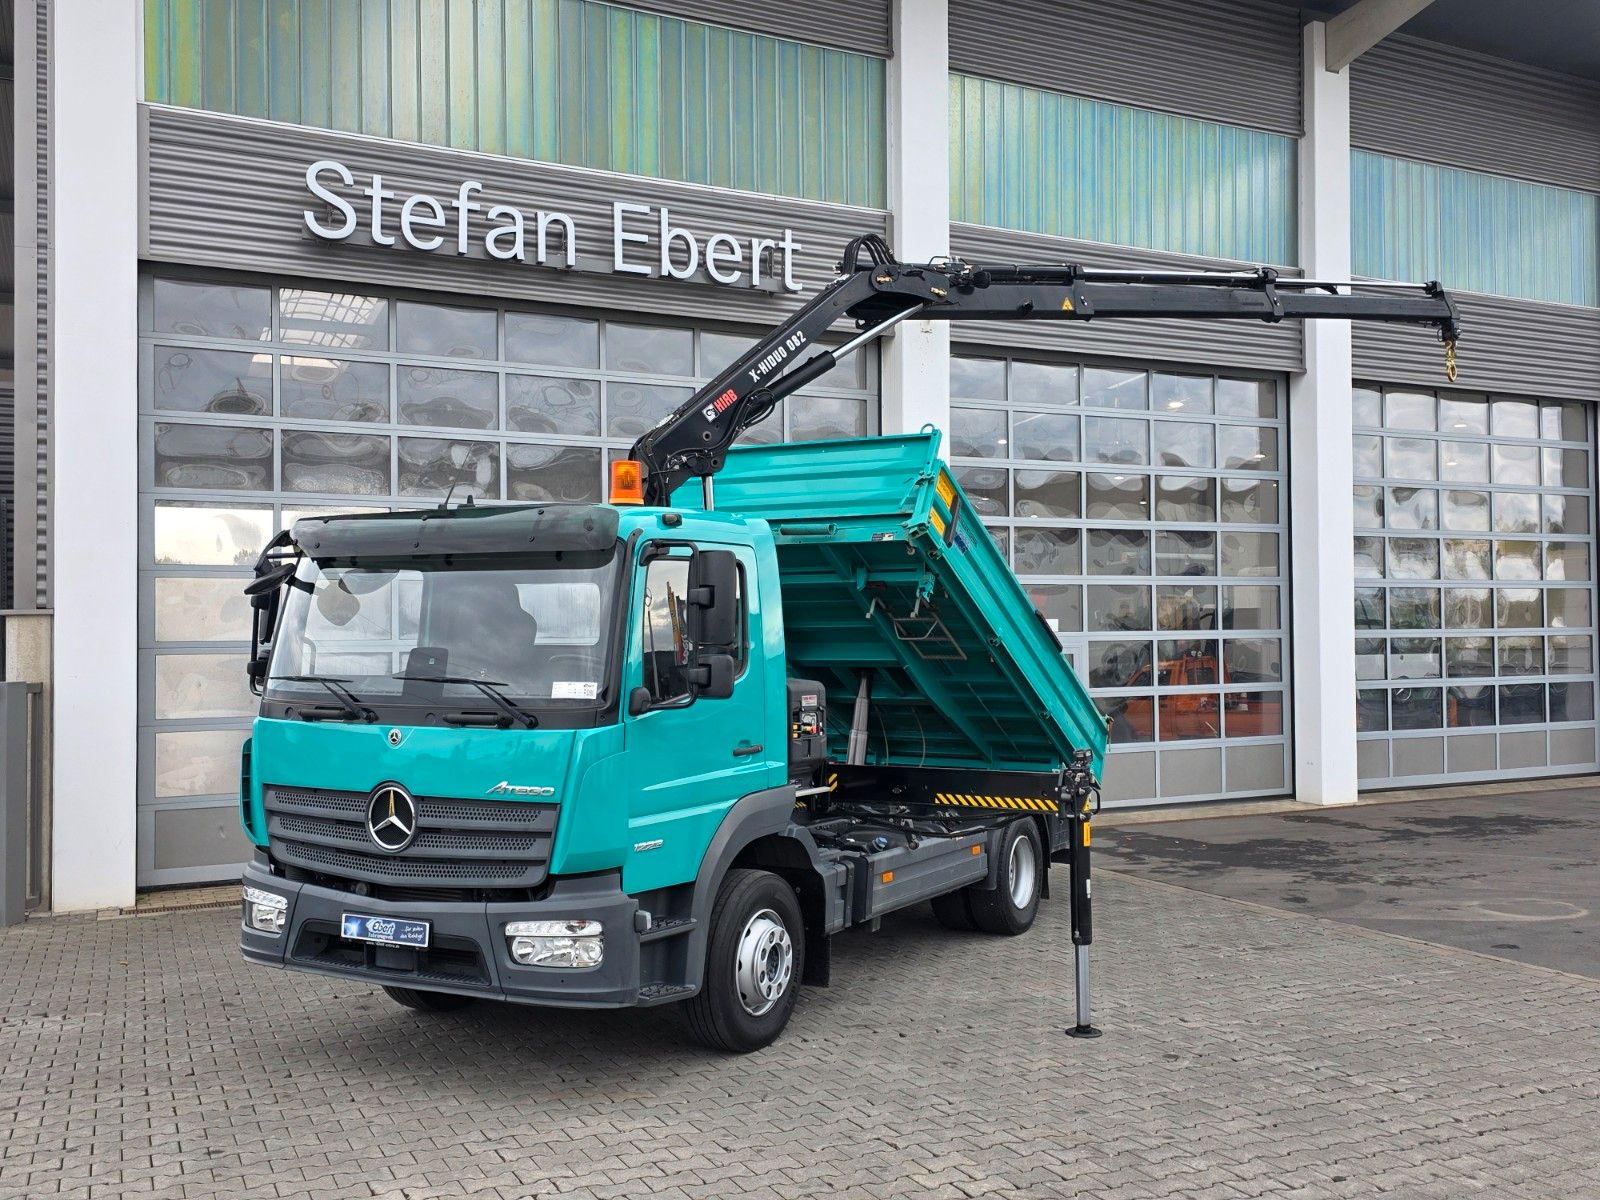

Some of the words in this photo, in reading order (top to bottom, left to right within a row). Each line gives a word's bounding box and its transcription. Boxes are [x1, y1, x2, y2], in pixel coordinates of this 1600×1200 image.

[303, 160, 577, 268] Stefan
[613, 201, 804, 292] Ebert
[748, 346, 788, 383] X-HIDUO
[786, 330, 807, 351] 082
[713, 388, 738, 413] HIAB
[372, 920, 395, 935] Ebert
